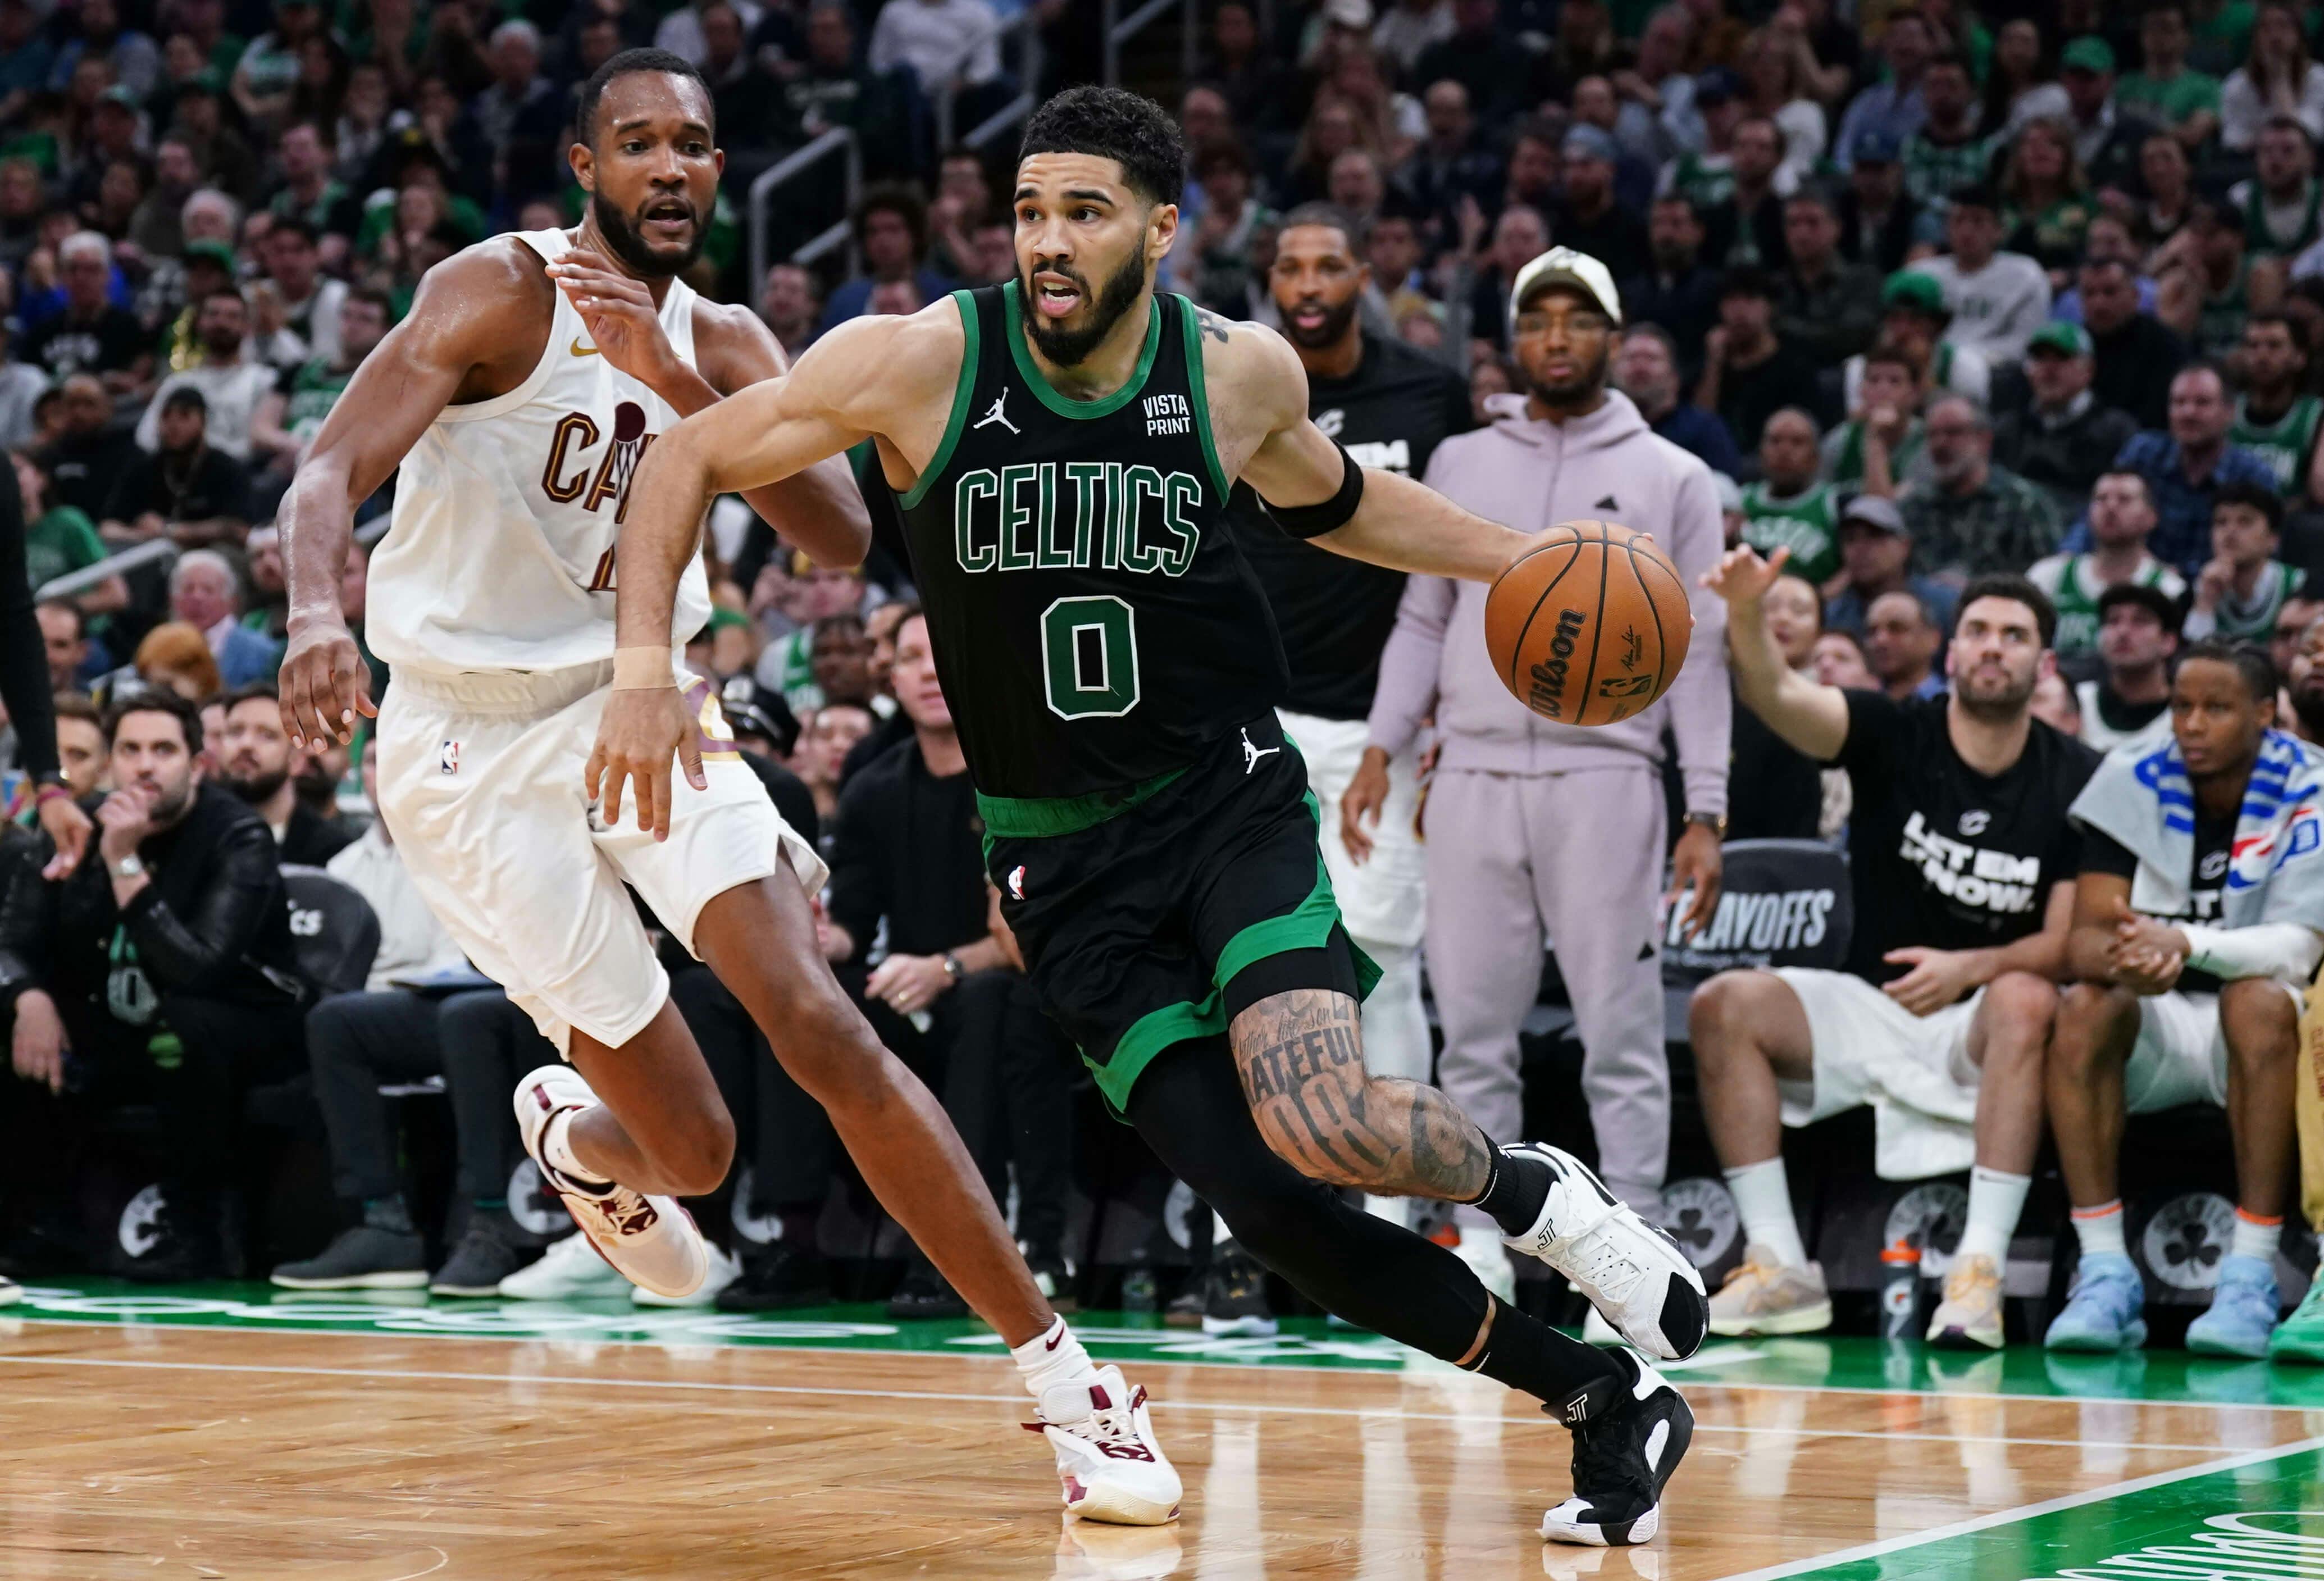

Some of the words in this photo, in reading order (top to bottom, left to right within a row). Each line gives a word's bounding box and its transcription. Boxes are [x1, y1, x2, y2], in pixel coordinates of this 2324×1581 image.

[1142, 394, 1190, 418] VISTA
[1146, 416, 1191, 436] PRINT
[955, 462, 1202, 577] CELTICS
[1040, 594, 1141, 721] 0
[1529, 608, 1587, 719] Wilson
[1972, 848, 2040, 886] EM
